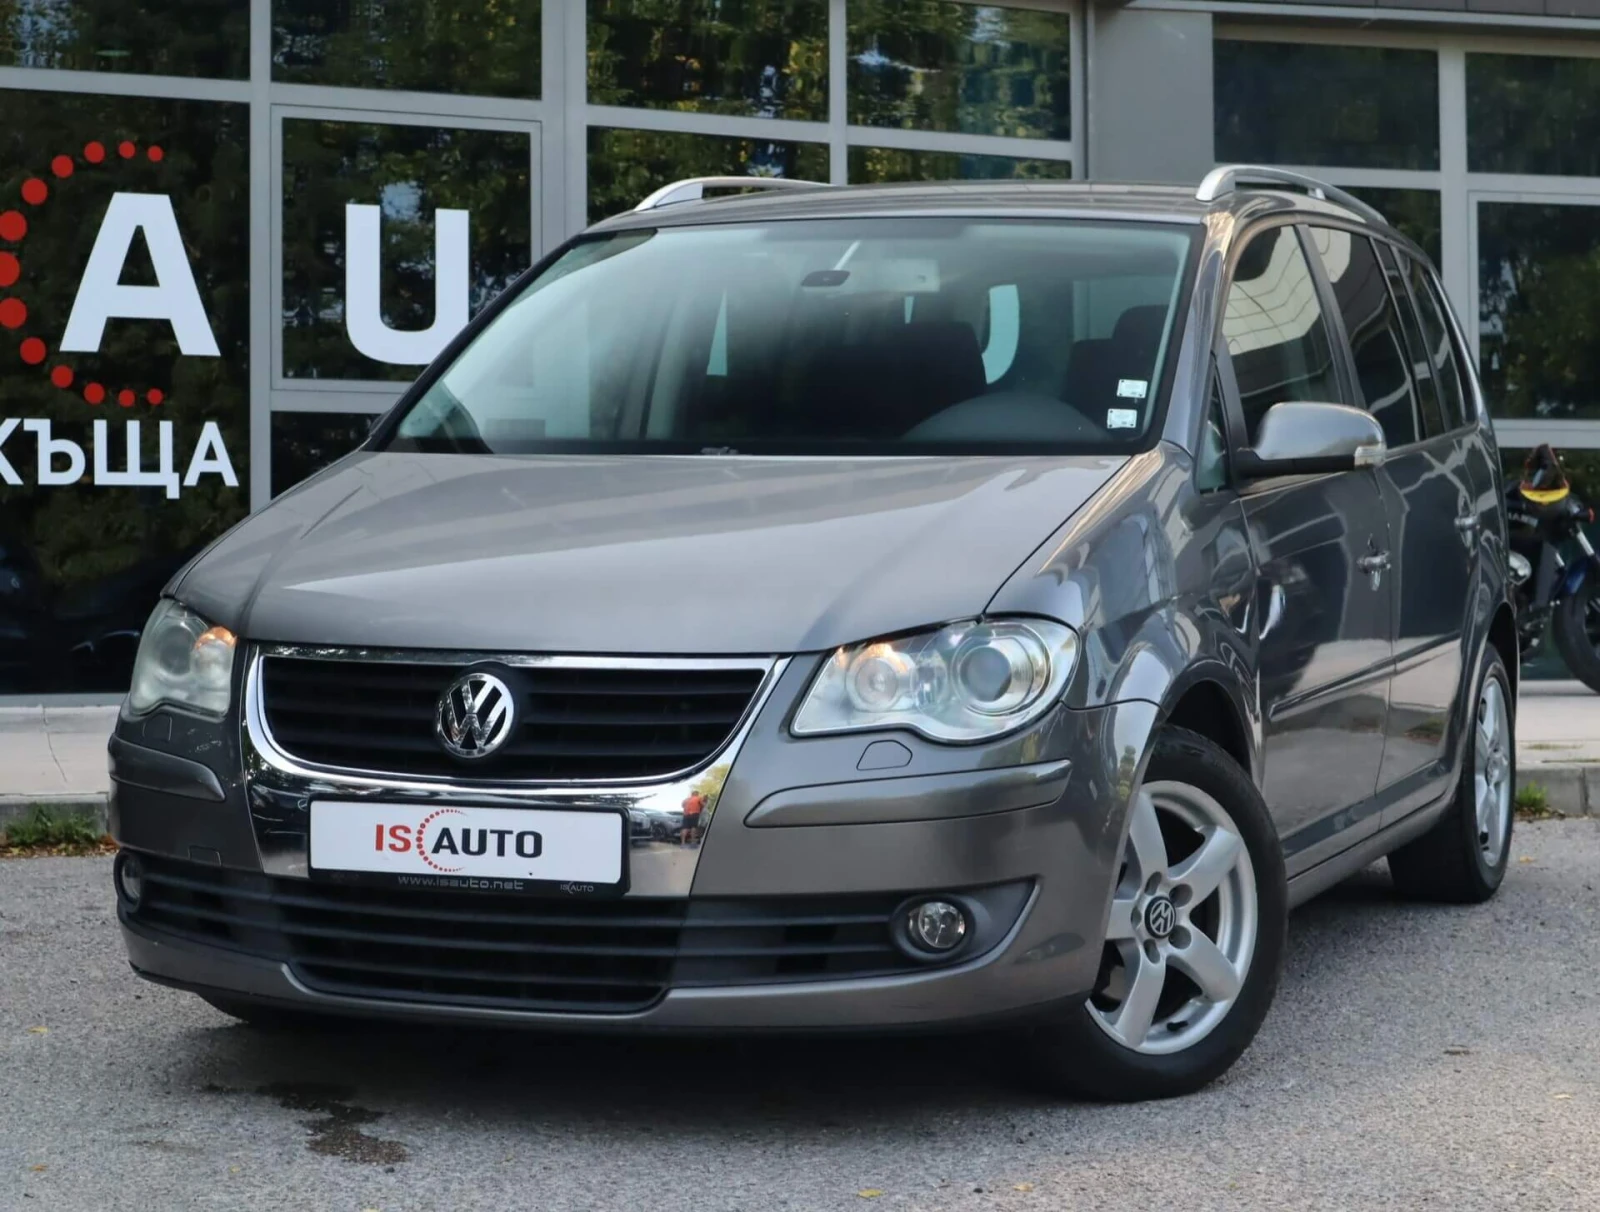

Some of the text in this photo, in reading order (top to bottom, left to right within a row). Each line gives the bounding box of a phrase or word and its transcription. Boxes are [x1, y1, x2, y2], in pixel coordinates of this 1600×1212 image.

[375, 823, 543, 859] IS AUTO
[397, 874, 525, 890] www.isauto.net
